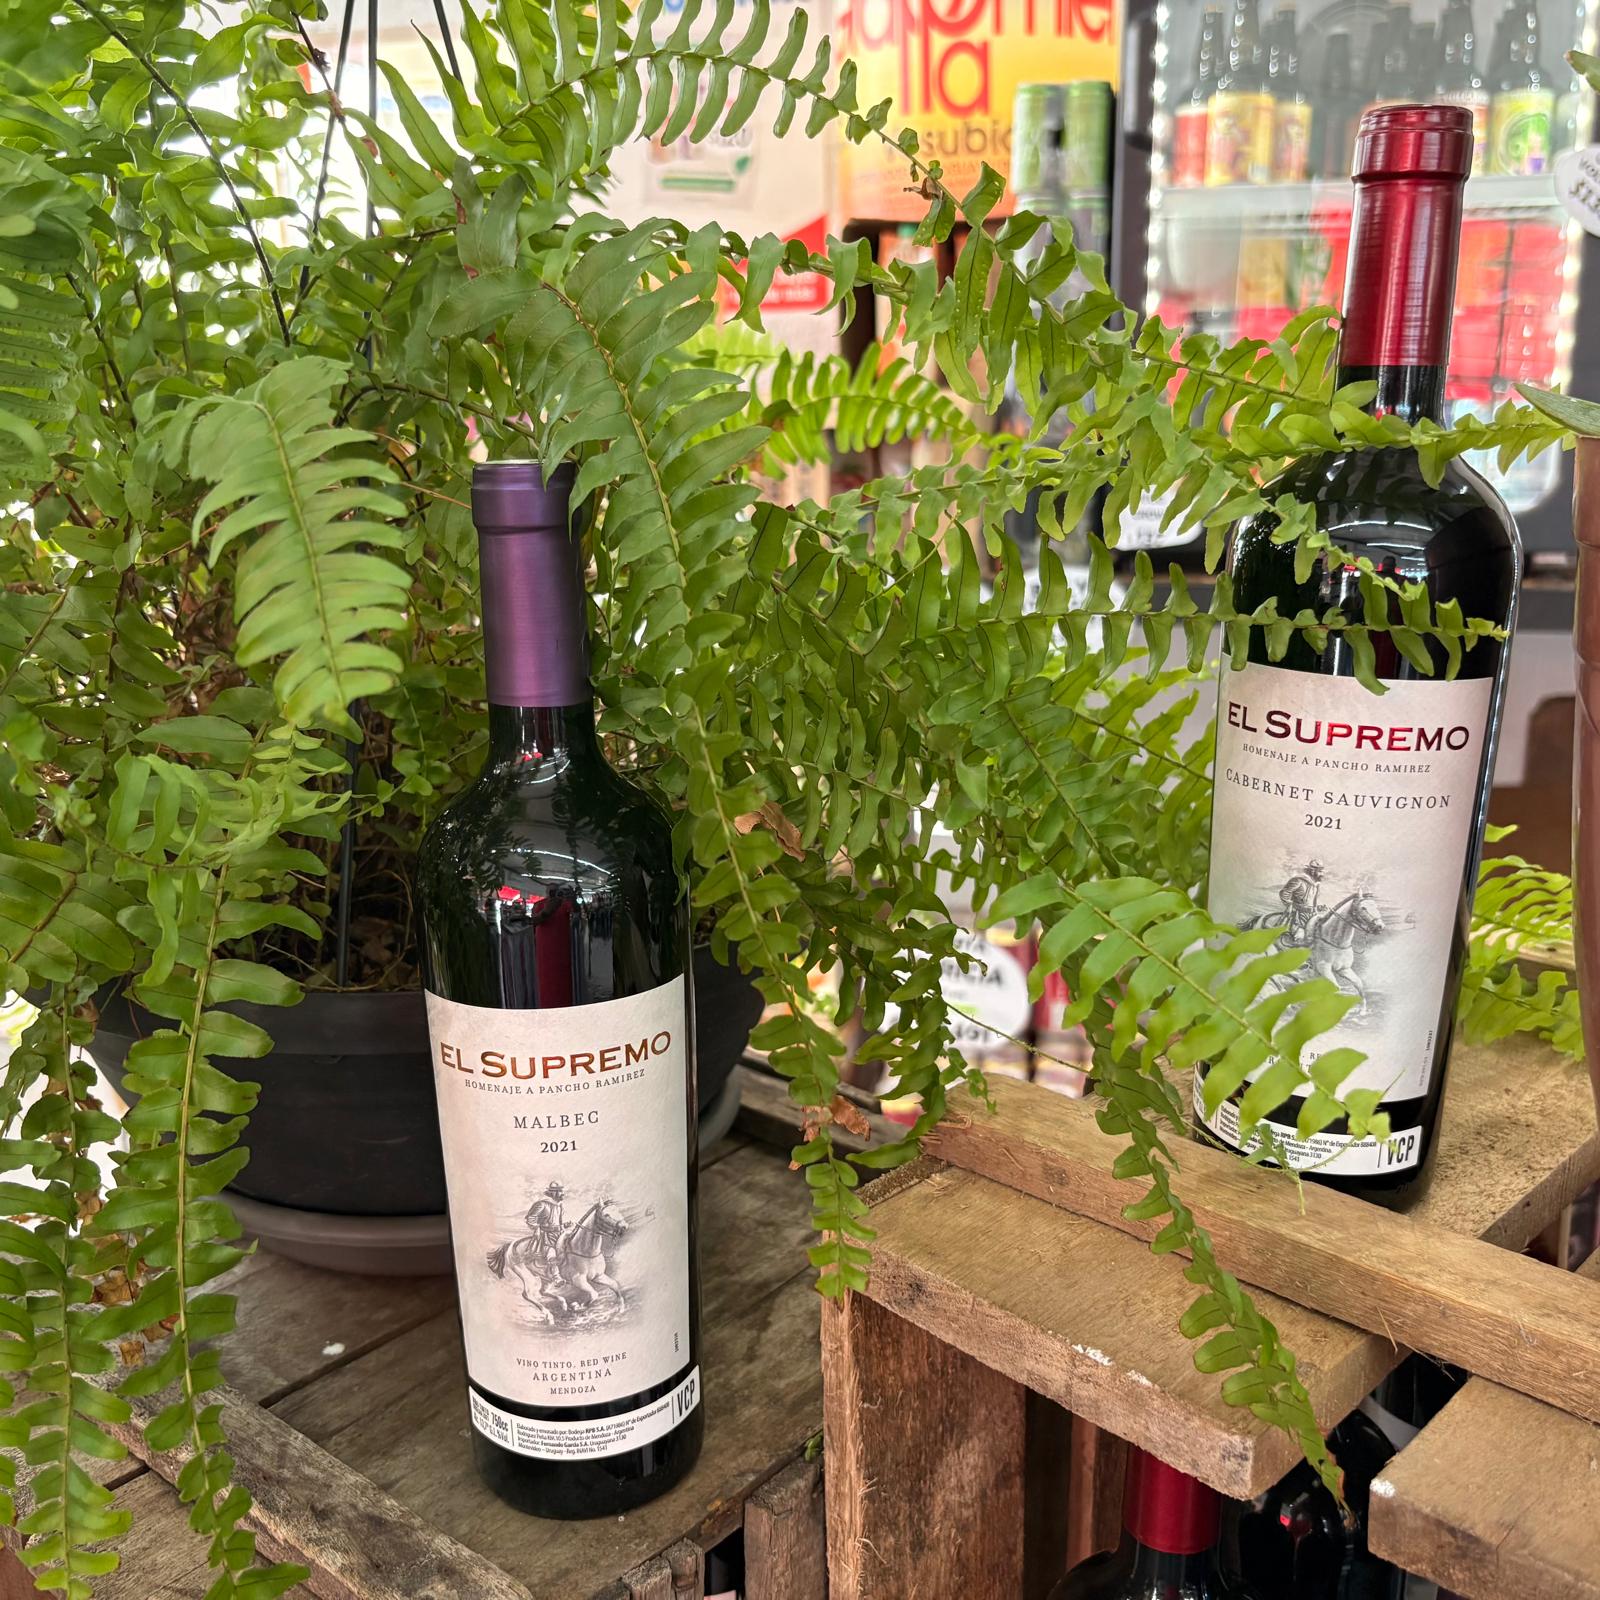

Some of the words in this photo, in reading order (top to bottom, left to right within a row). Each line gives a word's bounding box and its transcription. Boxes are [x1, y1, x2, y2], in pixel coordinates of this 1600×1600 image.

[1227, 701, 1257, 733] EL
[1265, 710, 1470, 752] SUPREMO
[1243, 743, 1297, 763] HOMENAJE
[1301, 756, 1309, 765] A
[1315, 758, 1369, 771] PANCHO
[1375, 763, 1431, 773] RAMIREZ
[1226, 768, 1314, 802] CABERNET
[1323, 791, 1451, 809] SAUVIGNON
[1304, 814, 1342, 830] 2021
[440, 1042, 474, 1074] EL
[480, 1030, 671, 1080] SUPREMO
[465, 1079, 521, 1095] HOMENAJE
[539, 1081, 590, 1095] PANCHO
[595, 1068, 645, 1088] RAMIREZ
[513, 1110, 599, 1129] MALBEC
[540, 1140, 577, 1153] 2021
[1387, 1134, 1415, 1166] VCP
[516, 1357, 539, 1368] VINO
[580, 1358, 599, 1367] RED
[602, 1352, 627, 1364] WINE
[532, 1368, 612, 1382] ARGENTINA
[550, 1385, 596, 1395] MENDOZA
[677, 1378, 695, 1416] VCP
